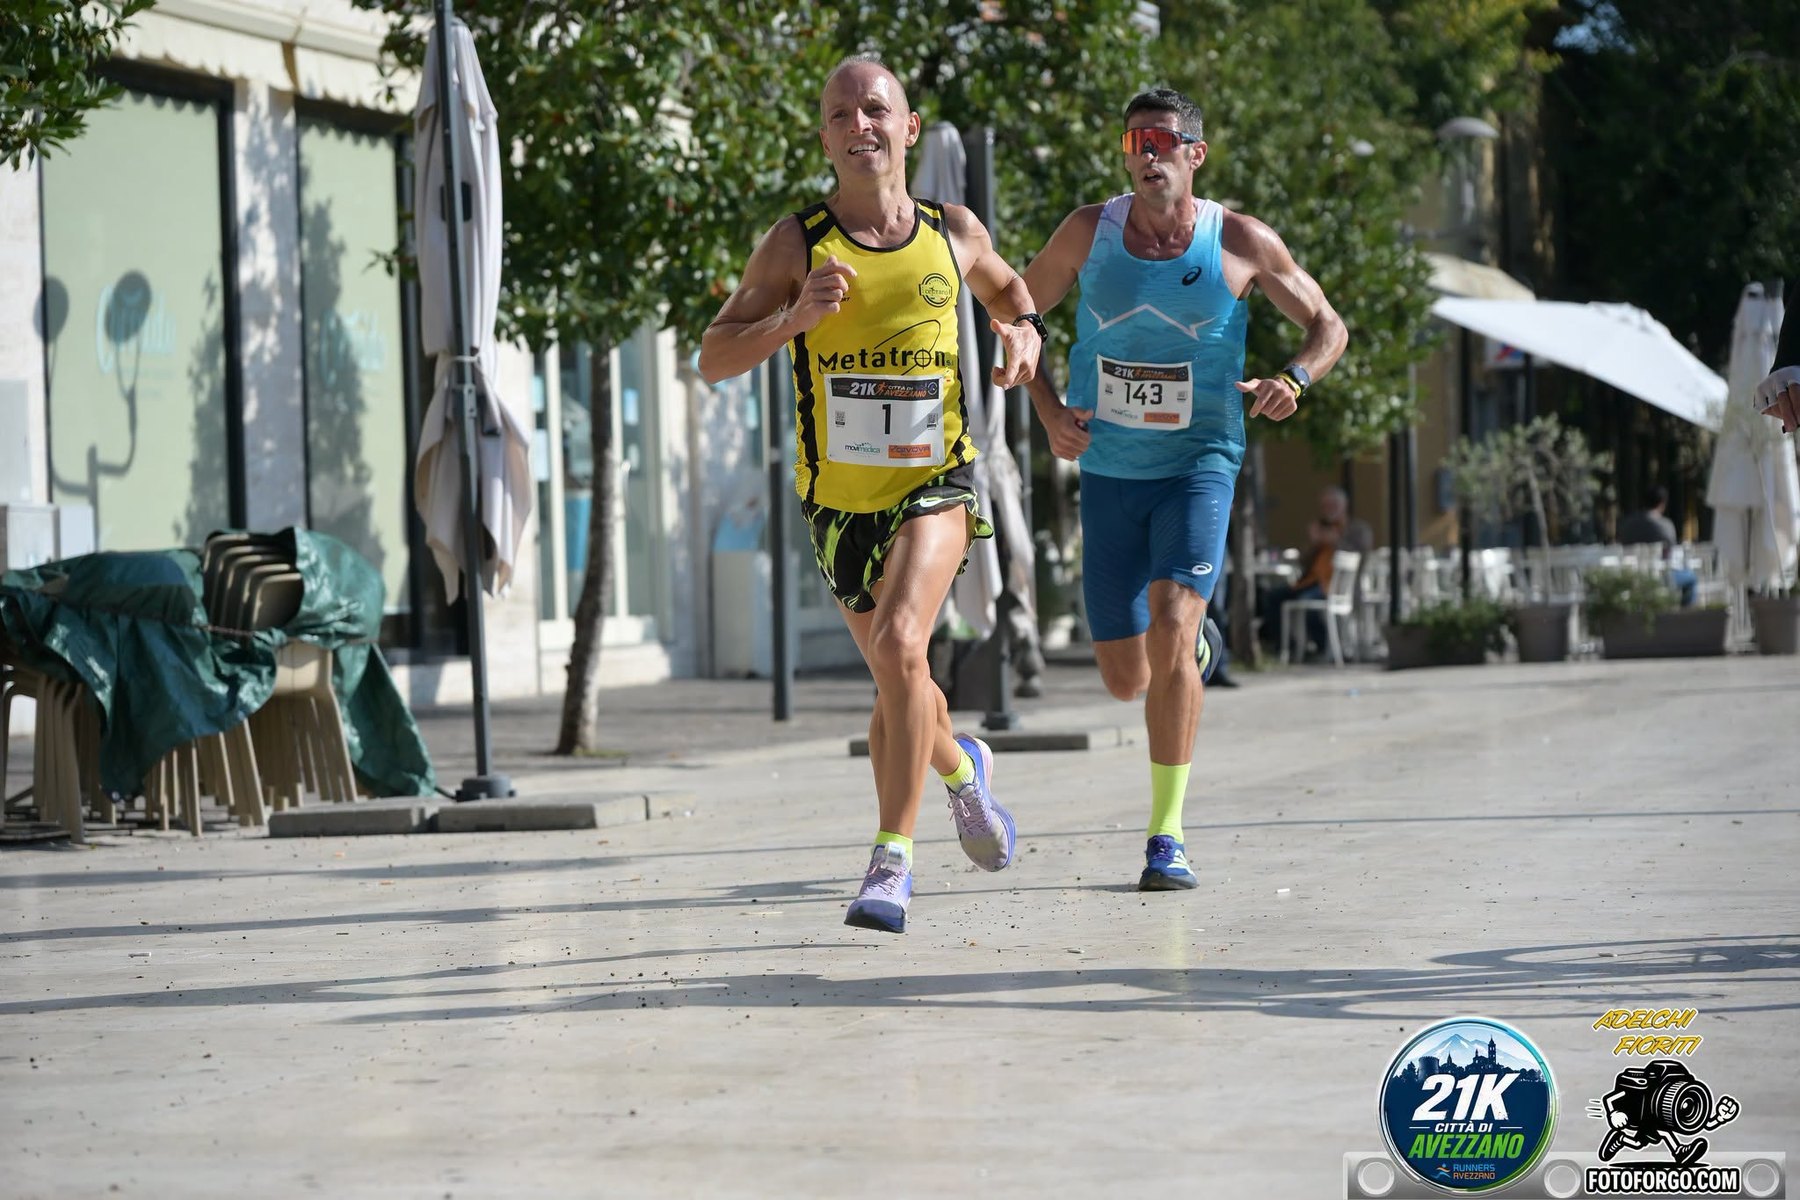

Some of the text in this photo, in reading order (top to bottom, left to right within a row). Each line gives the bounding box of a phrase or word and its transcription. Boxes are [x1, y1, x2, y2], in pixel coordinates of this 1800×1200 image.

[818, 347, 946, 373] Metatron
[1114, 366, 1135, 379] 21K
[849, 381, 877, 396] 21K
[1124, 382, 1163, 406] 143
[882, 403, 892, 434] 1
